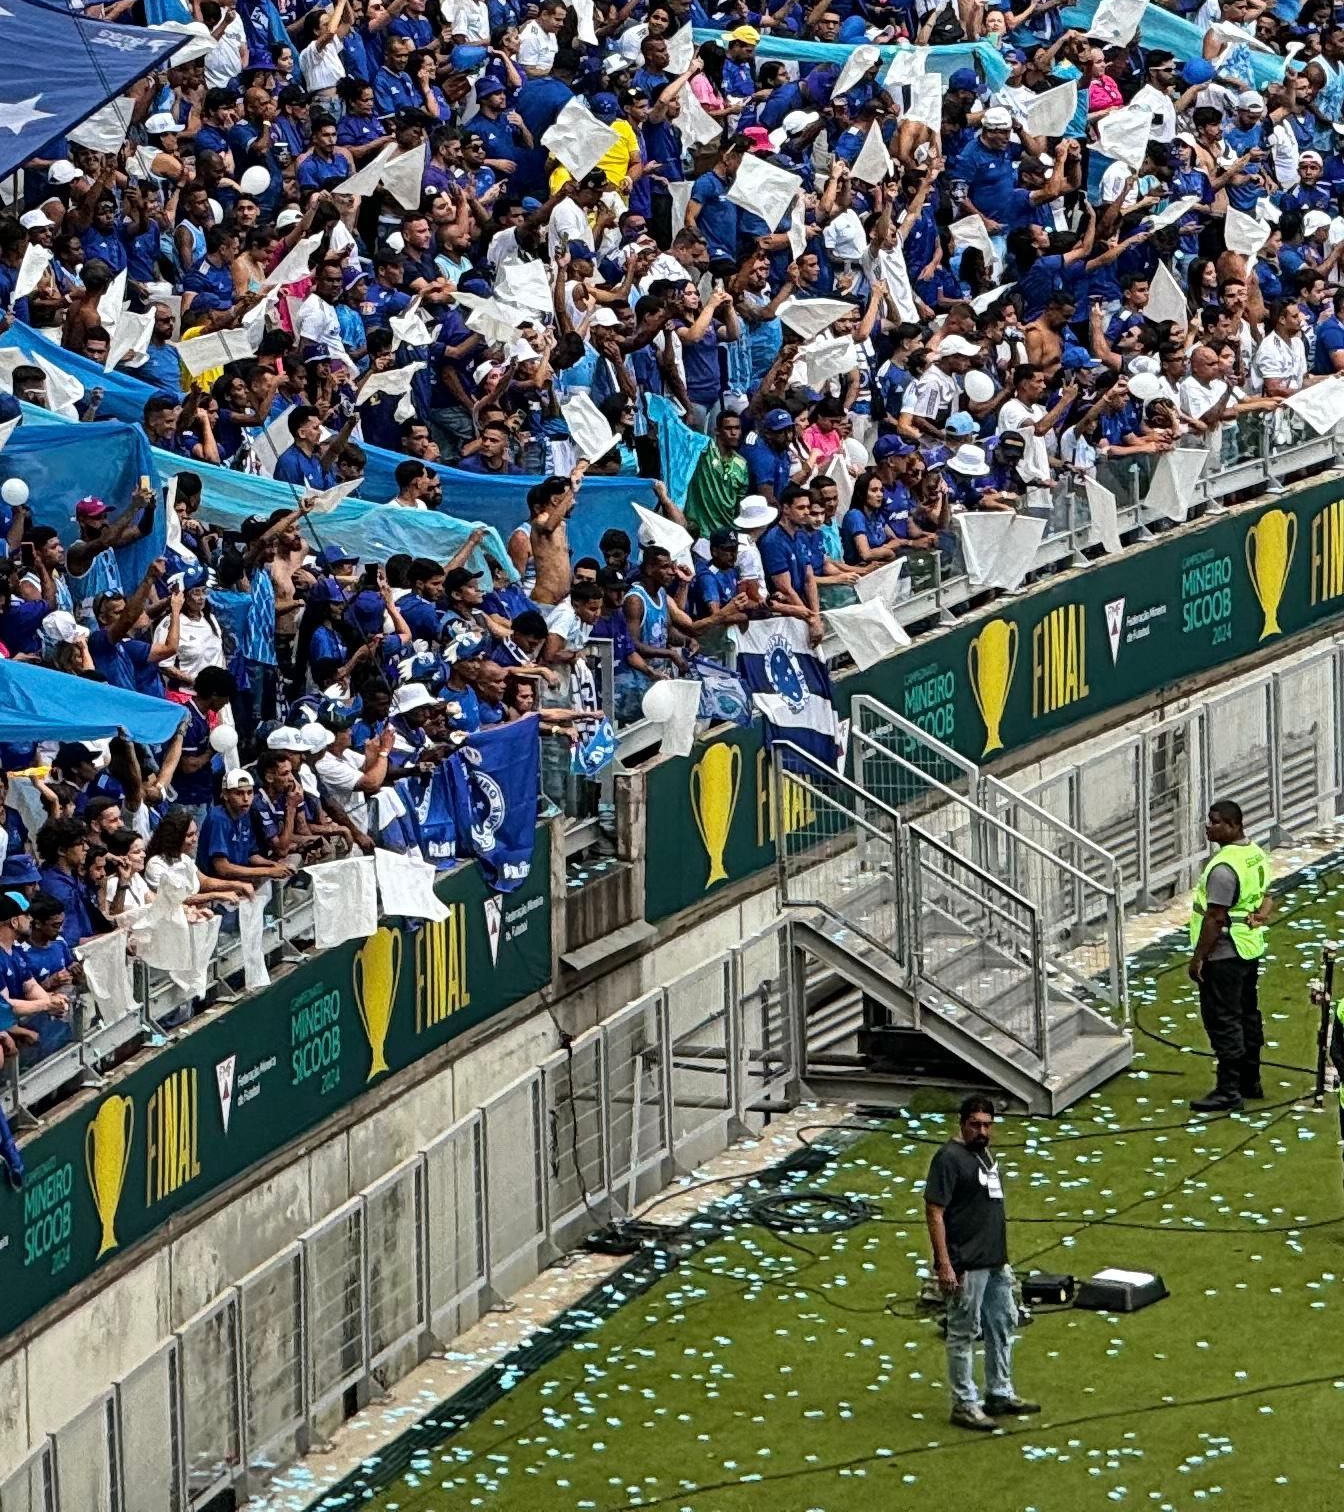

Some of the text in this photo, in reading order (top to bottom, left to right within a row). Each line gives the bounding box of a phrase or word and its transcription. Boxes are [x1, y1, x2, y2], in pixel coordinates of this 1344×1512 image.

[1181, 555, 1232, 600] MINEIRO
[1181, 587, 1232, 633] SICOOB
[1031, 603, 1090, 720] FINAL
[904, 670, 955, 717] MINEIRO
[415, 902, 471, 1034] FINAL
[291, 989, 341, 1047] MINEIRO
[292, 1025, 341, 1086] SICOOB
[145, 1066, 201, 1210] FINAL
[24, 1162, 72, 1225] MINEIRO
[24, 1200, 72, 1267] SICOOB
